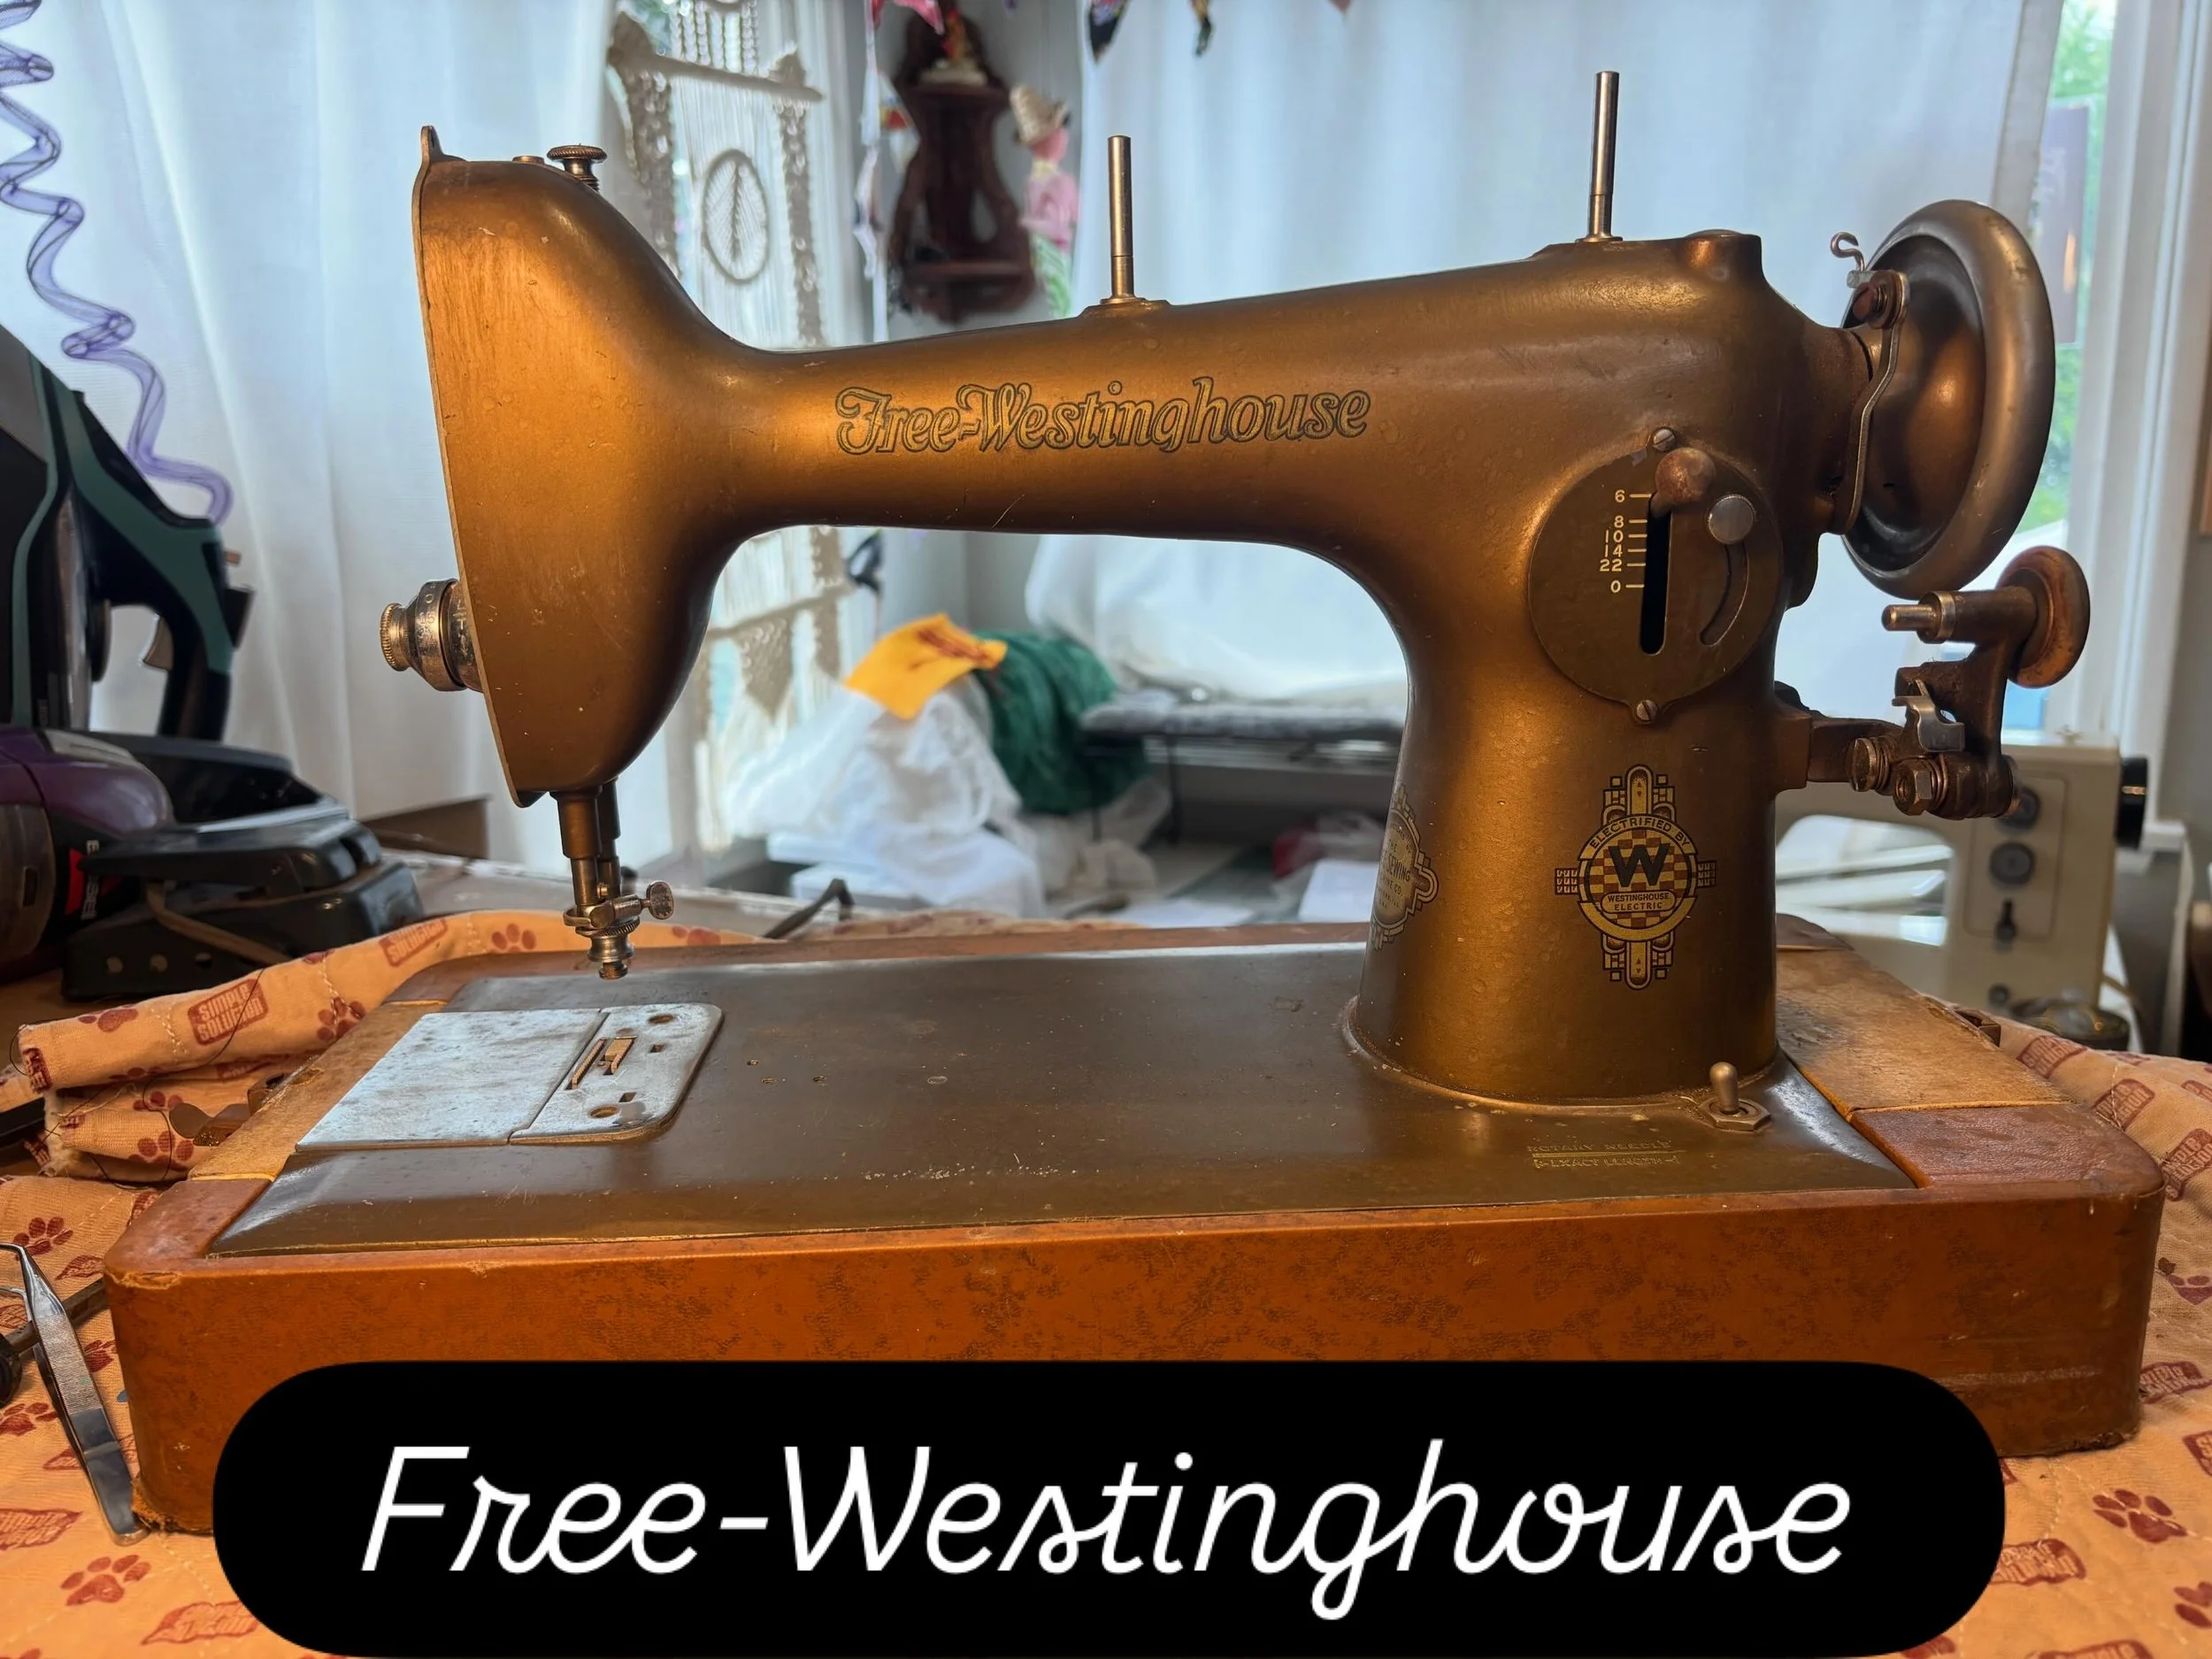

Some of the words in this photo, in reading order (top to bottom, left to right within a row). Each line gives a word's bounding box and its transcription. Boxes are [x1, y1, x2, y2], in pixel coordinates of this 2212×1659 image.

[835, 377, 1371, 455] Free-Westinghouse
[1615, 489, 1625, 503] 6
[1614, 515, 1624, 528] 8
[1605, 530, 1624, 542] 10
[1604, 544, 1623, 557] 14
[1599, 558, 1622, 572] 22
[1610, 580, 1621, 593] 0
[1590, 818, 1671, 849] ELECTRIFIED
[1675, 832, 1691, 846] BY
[1386, 854, 1411, 882] SEWING
[1609, 842, 1671, 887] W
[1608, 893, 1671, 902] WESTINGHOUSE
[1614, 902, 1663, 911] ELECTRIC
